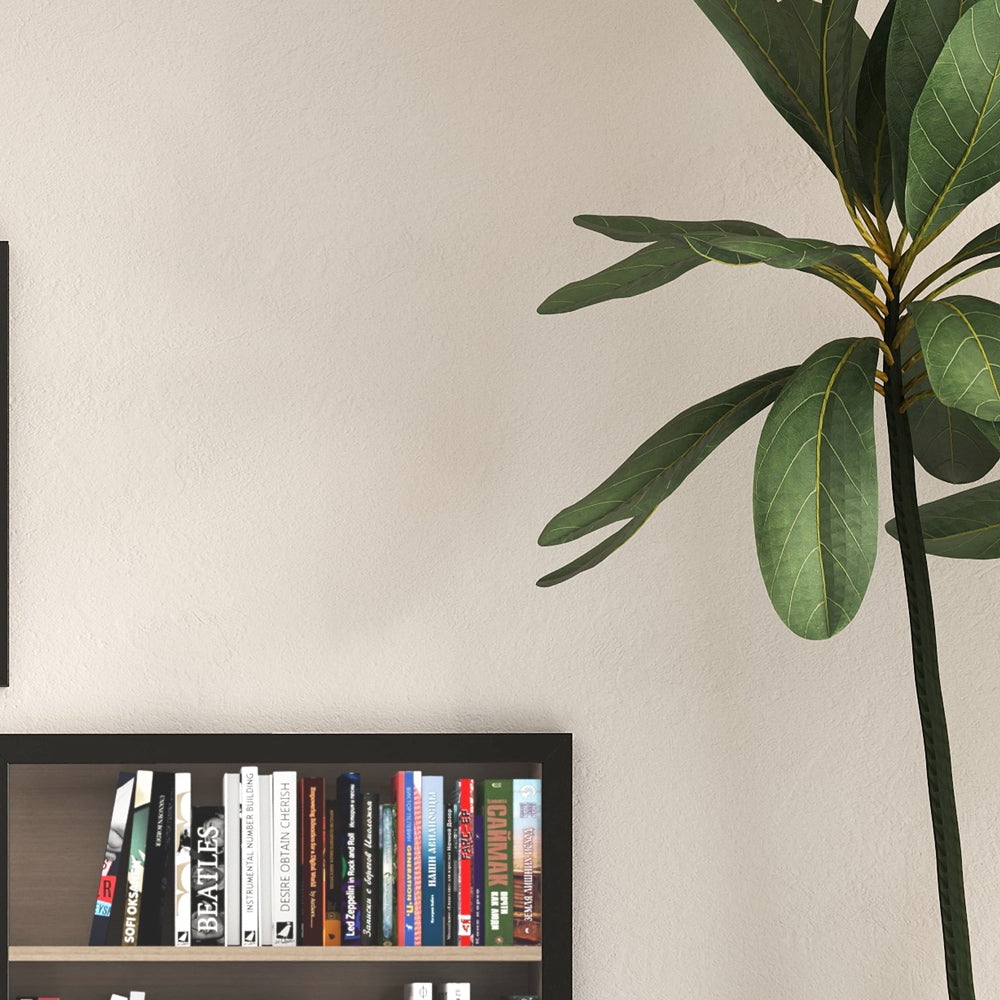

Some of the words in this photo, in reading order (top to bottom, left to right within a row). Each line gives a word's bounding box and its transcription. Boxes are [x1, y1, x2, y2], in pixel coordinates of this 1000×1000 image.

[245, 772, 254, 811] BUILDING
[280, 782, 291, 828] CHERISH
[246, 815, 254, 848] NUMBER
[347, 833, 355, 845] Roll
[460, 810, 470, 860] FARC-EP
[487, 803, 511, 887] САЙМАК
[280, 832, 291, 873] OBTAIN
[347, 860, 355, 876] Rock
[197, 826, 220, 933] BEATLES
[246, 851, 254, 913] INSTRUMENTAL
[428, 856, 436, 887] НАШИ
[280, 876, 291, 912] DESIRE
[346, 885, 357, 919] Zeppelin
[124, 916, 135, 943] SOFI
[346, 922, 355, 936] Led
[363, 898, 372, 937] Записки
